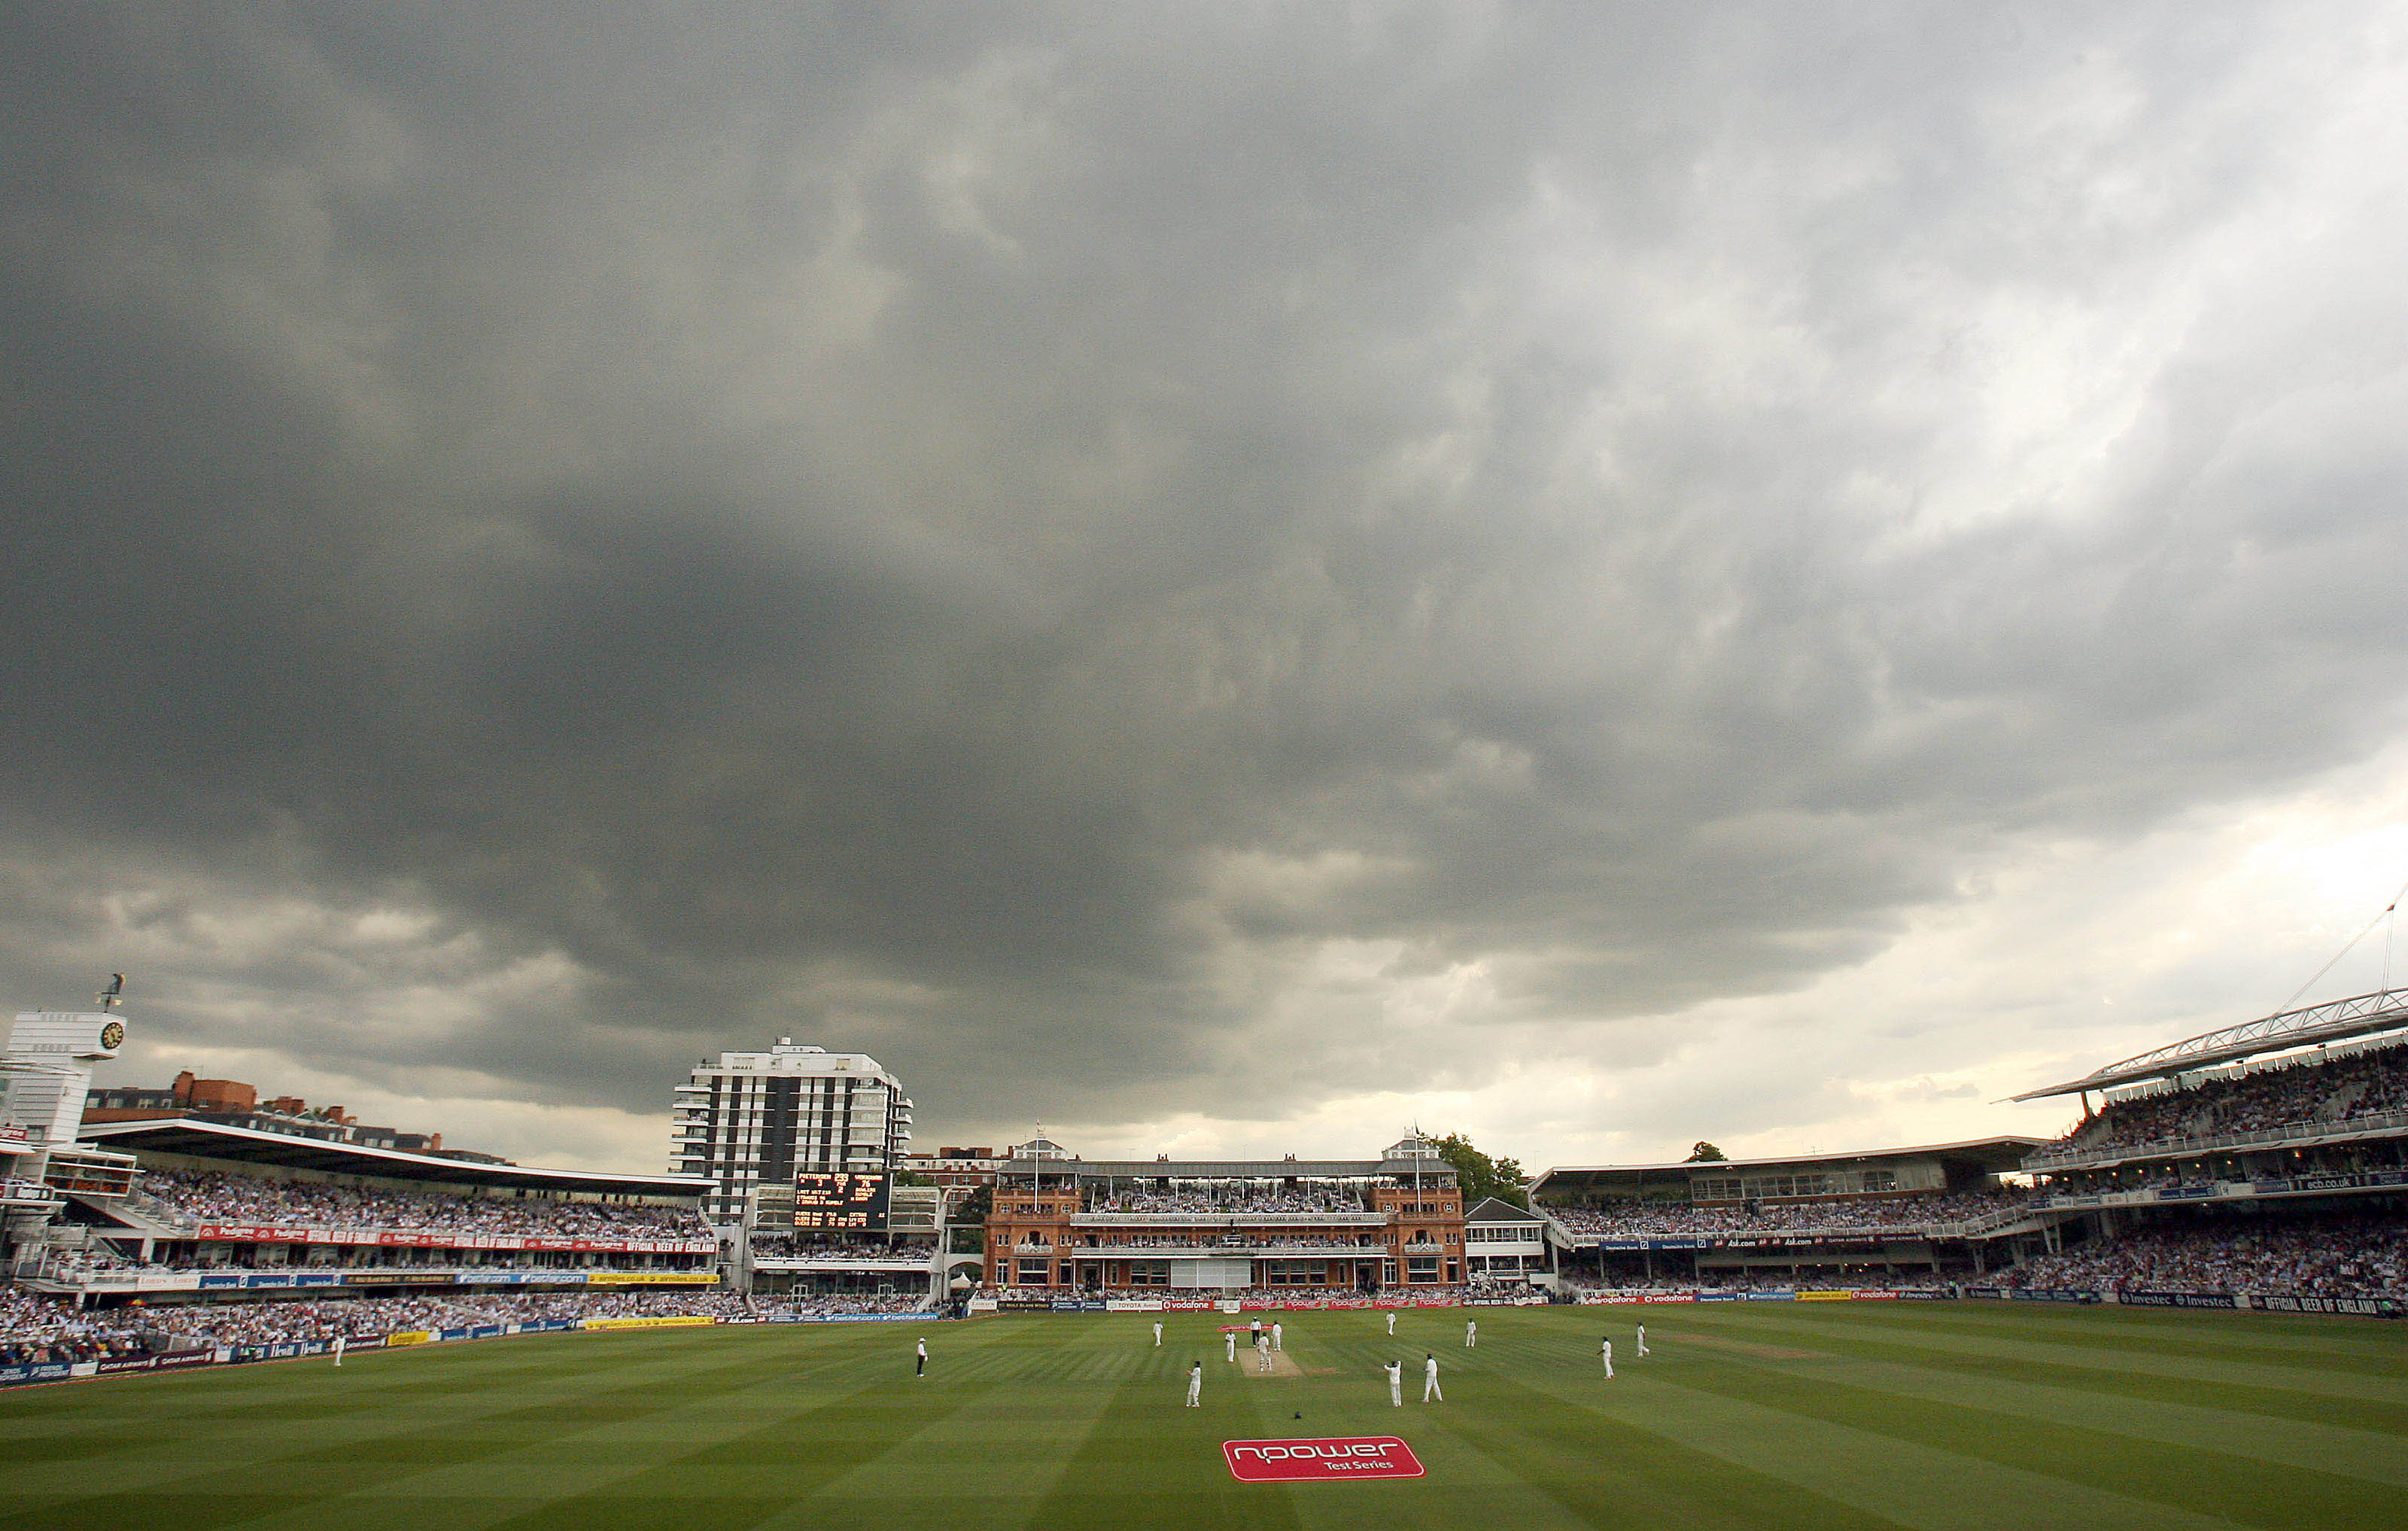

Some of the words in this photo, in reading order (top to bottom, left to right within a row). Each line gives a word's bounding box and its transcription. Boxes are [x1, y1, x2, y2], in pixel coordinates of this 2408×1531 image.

[835, 1173, 849, 1182] 233
[2307, 1177, 2351, 1190] ecb.co.uk
[220, 1227, 255, 1237] Pedigree
[590, 1241, 624, 1249] Pedigree
[1728, 1237, 1756, 1247] Ask.com
[1784, 1237, 1812, 1246] Ask.com
[627, 1242, 654, 1252] OFFICIAL
[655, 1242, 673, 1252] BEER
[674, 1243, 684, 1252] OF
[685, 1242, 716, 1253] ENGLAND
[1653, 1294, 1693, 1303] vodafone
[1860, 1291, 1896, 1299] vodafone
[2130, 1293, 2171, 1305] Investec
[2187, 1295, 2233, 1307] Investec
[2264, 1297, 2300, 1311] OFFICIAL
[2300, 1298, 2323, 1312] BEER
[2324, 1299, 2334, 1312] OF
[2335, 1299, 2377, 1314] ENGLAND
[100, 1362, 121, 1371] QATAR
[1234, 1444, 1398, 1464] npower
[1324, 1461, 1351, 1471] Test
[1354, 1459, 1394, 1470] Series
